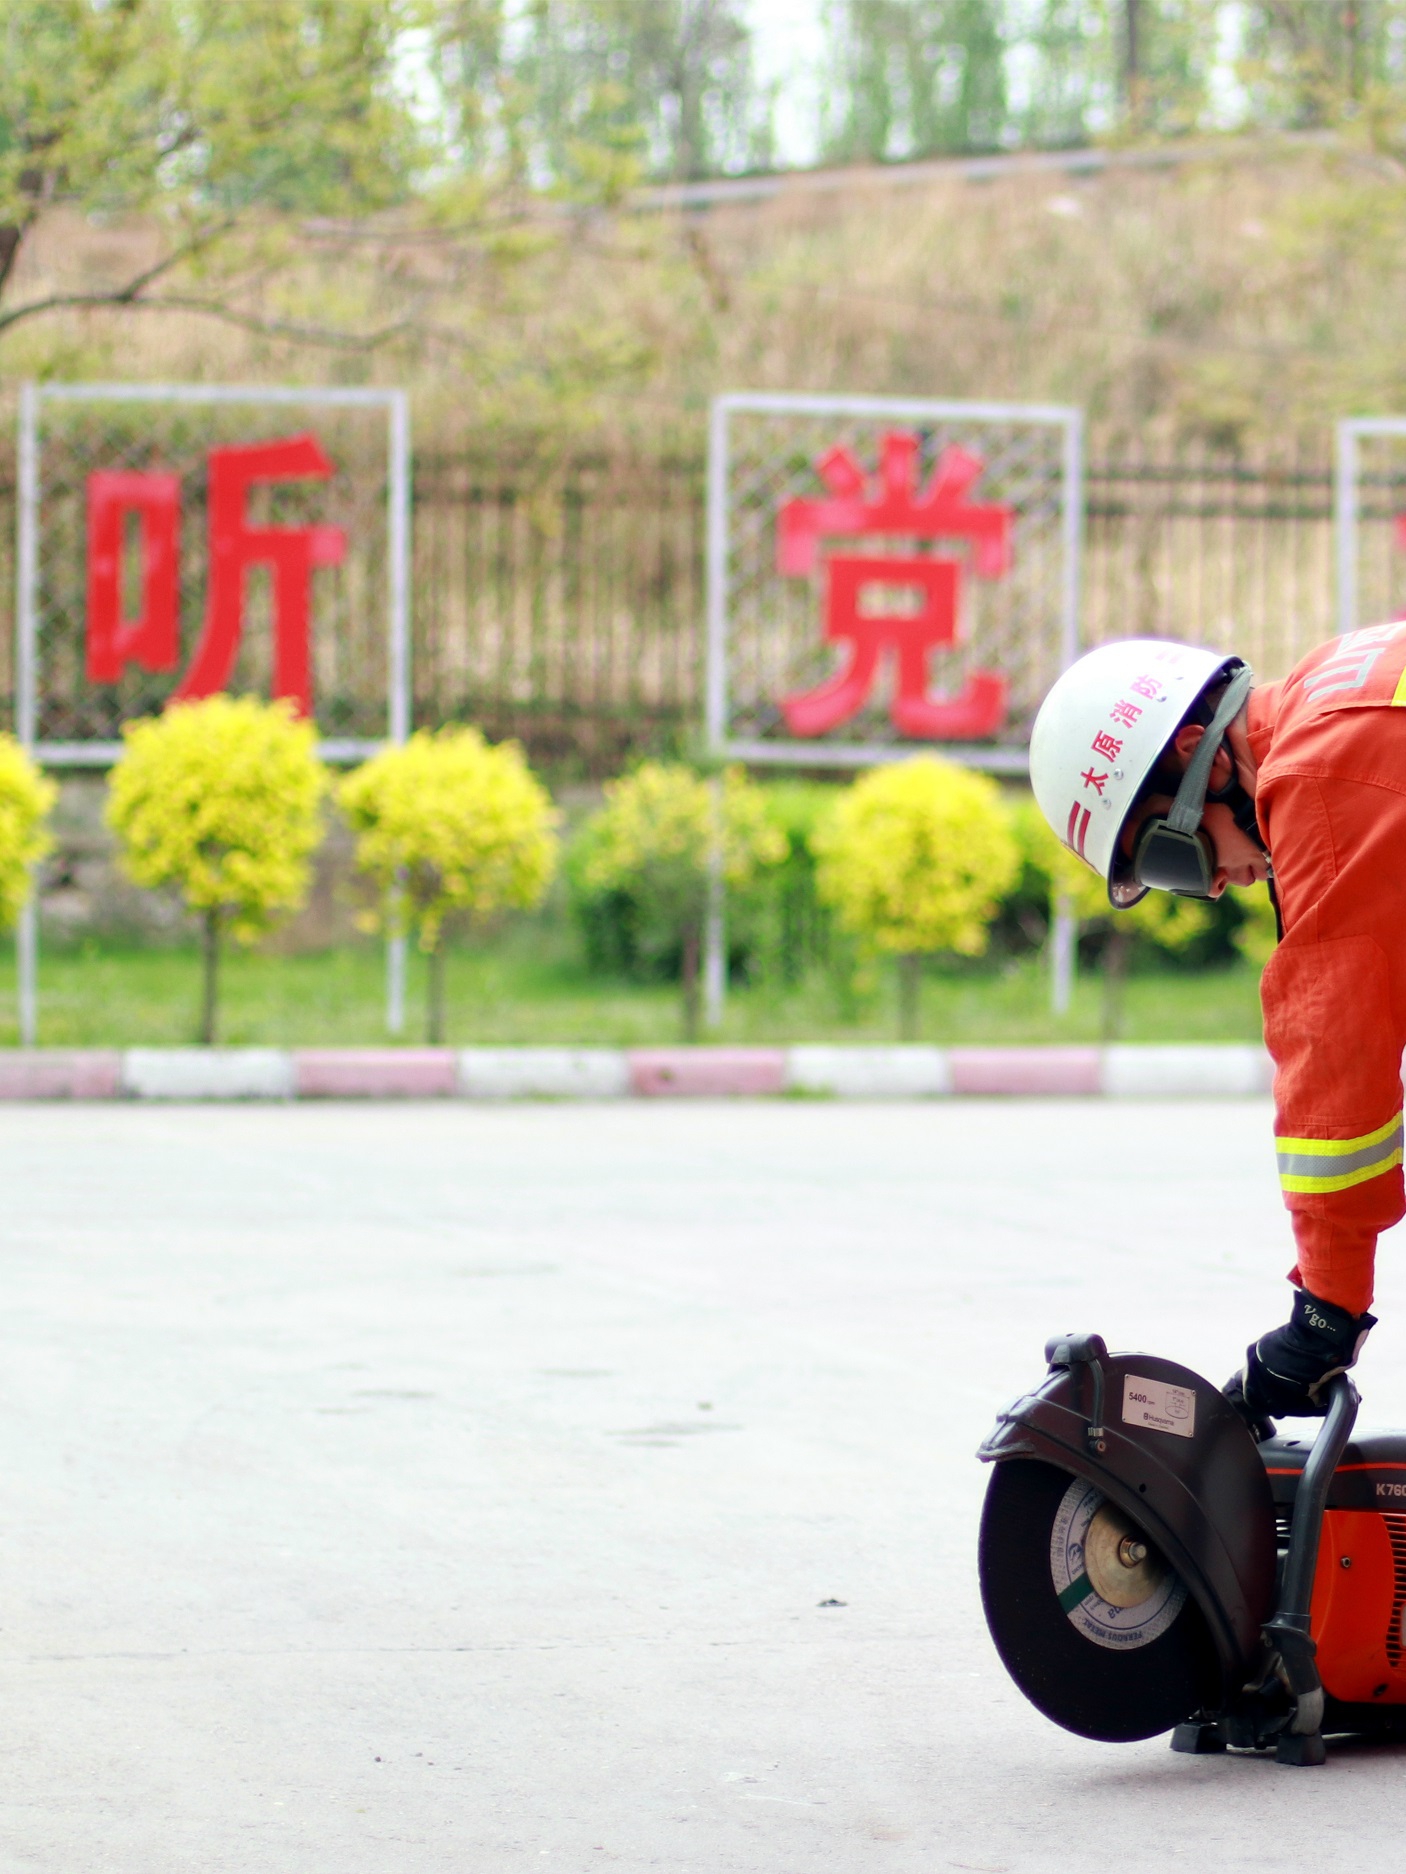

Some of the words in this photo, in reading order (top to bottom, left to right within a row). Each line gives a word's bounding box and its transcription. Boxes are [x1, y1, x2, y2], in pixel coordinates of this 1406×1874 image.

[86, 432, 349, 720] 听
[775, 429, 1016, 741] 党
[1080, 673, 1163, 797] 太原消防
[1128, 1391, 1147, 1403] 5400
